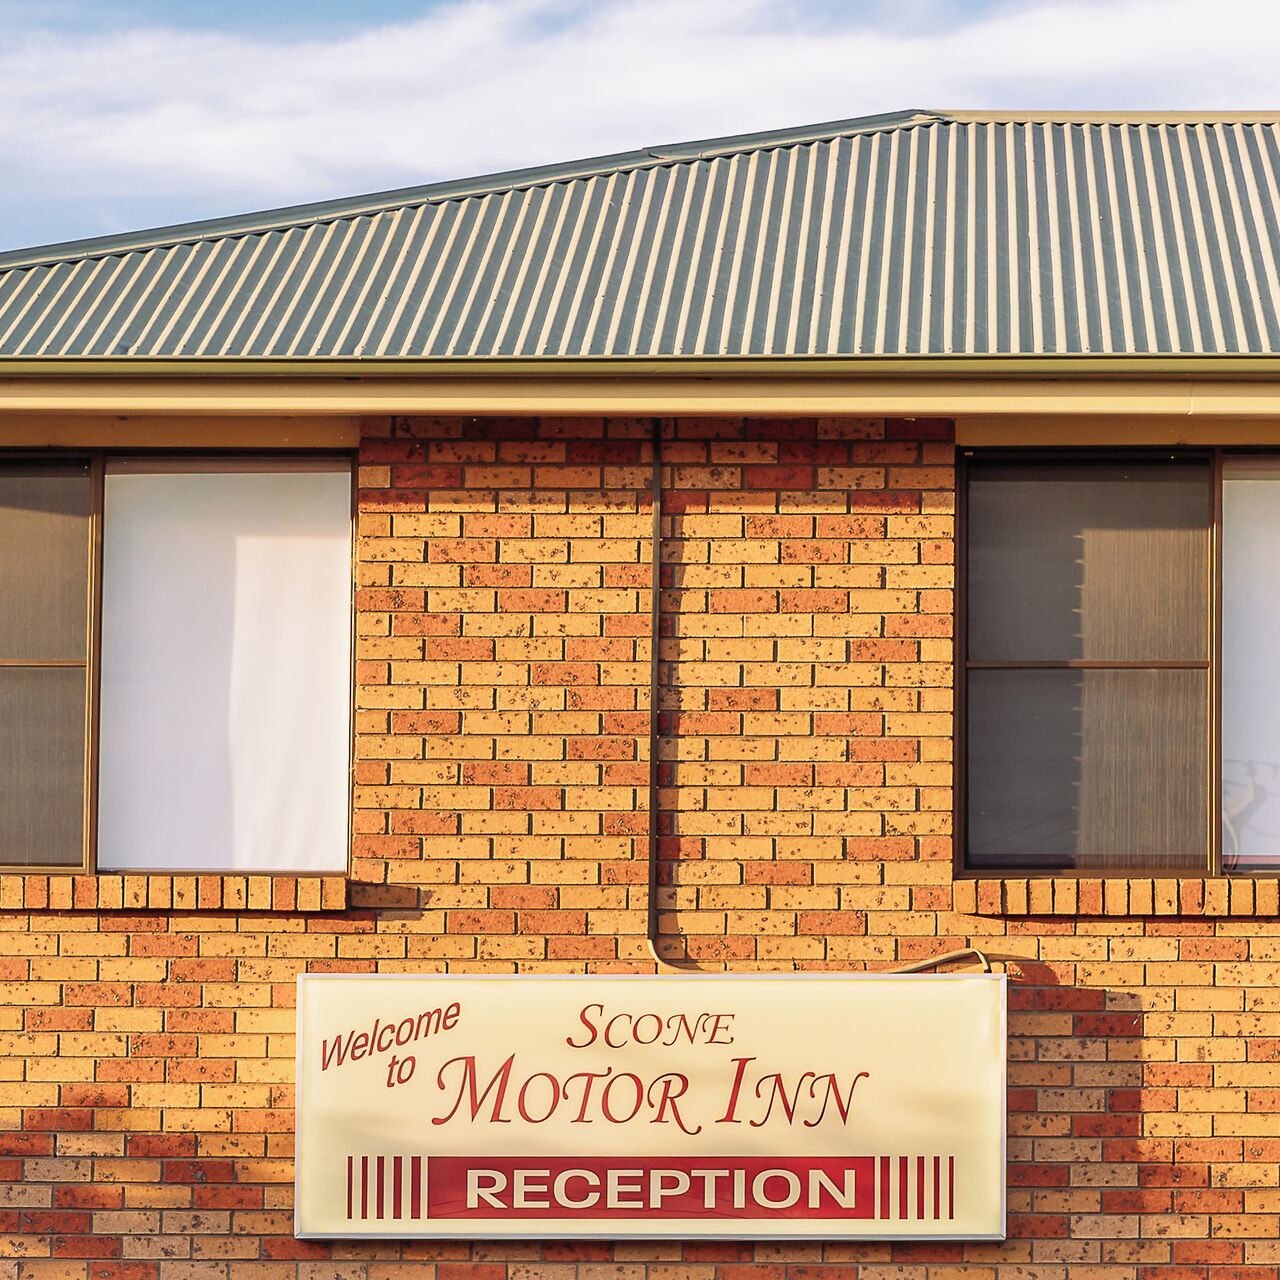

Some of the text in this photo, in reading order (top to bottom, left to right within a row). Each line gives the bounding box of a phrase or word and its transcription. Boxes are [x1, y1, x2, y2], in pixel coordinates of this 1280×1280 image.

[321, 1002, 461, 1073] Welcome
[566, 1003, 735, 1049] SCONE
[386, 1051, 416, 1088] to
[431, 1053, 870, 1136] MOTOR INN
[465, 1168, 856, 1210] RECEPTION
